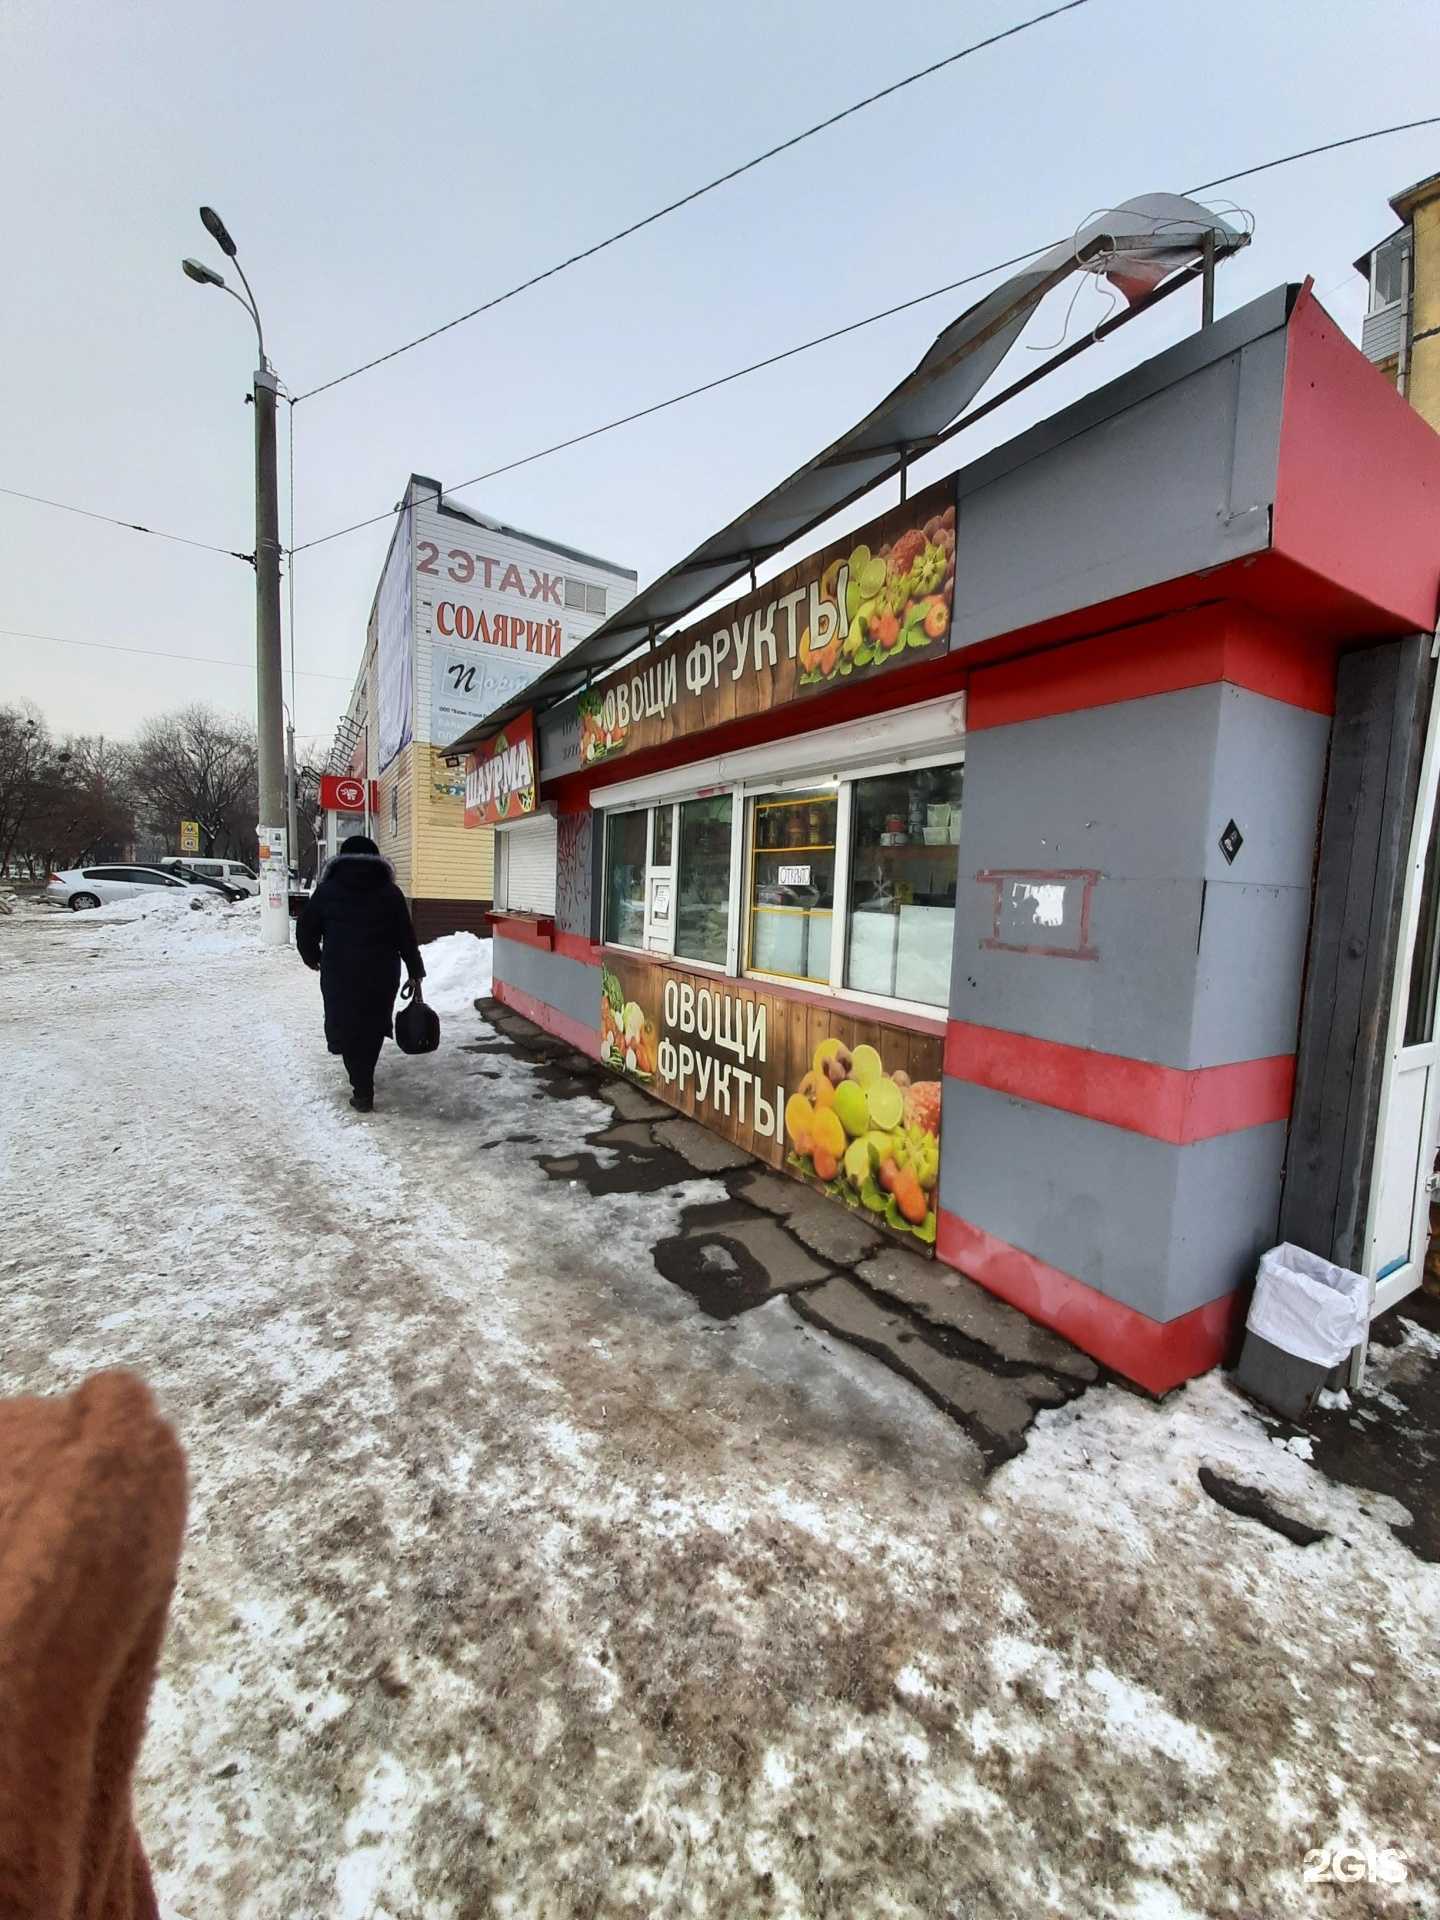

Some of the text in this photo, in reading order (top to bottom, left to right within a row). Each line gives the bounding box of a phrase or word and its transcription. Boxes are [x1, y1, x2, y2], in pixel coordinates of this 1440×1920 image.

[416, 541, 563, 605] 2 ЭТАЖ
[436, 601, 563, 657] СОЛЯРИЙ
[604, 564, 849, 732] ОВОЩИ ФРУКТЫ
[465, 740, 531, 809] ШАУРМА
[664, 979, 768, 1062] ОВОЩИ
[657, 1037, 784, 1144] ФРУКТЫ
